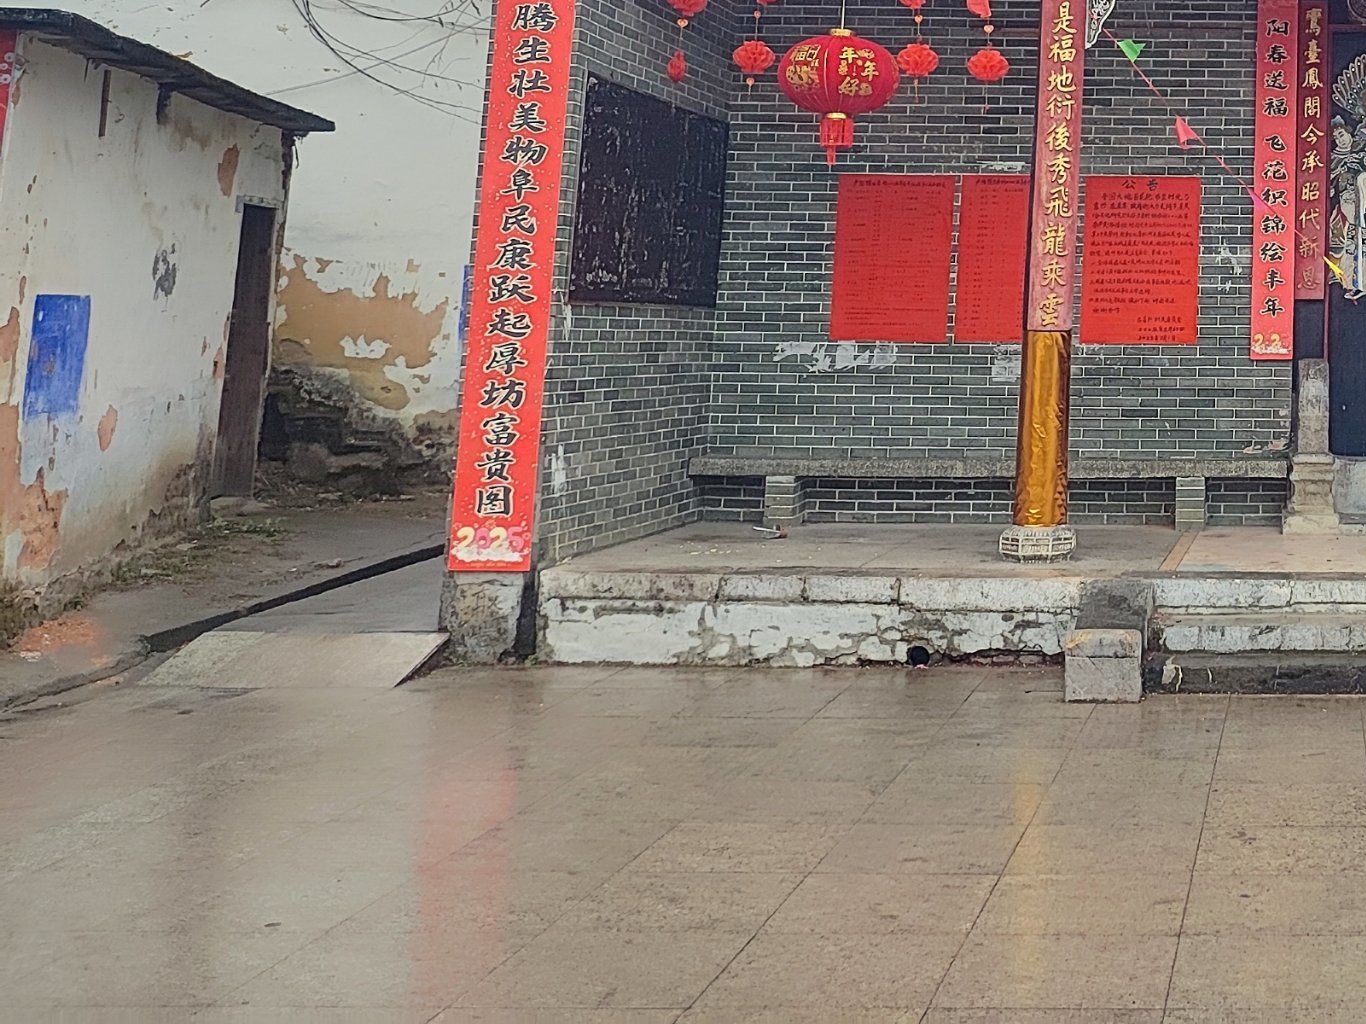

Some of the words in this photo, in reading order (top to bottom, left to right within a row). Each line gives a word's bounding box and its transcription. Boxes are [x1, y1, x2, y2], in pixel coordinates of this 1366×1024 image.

[1259, 20, 1291, 317] 阳春送福飞花织锦绘丰年
[1122, 179, 1159, 192] 公告
[456, 526, 525, 552] 2025
